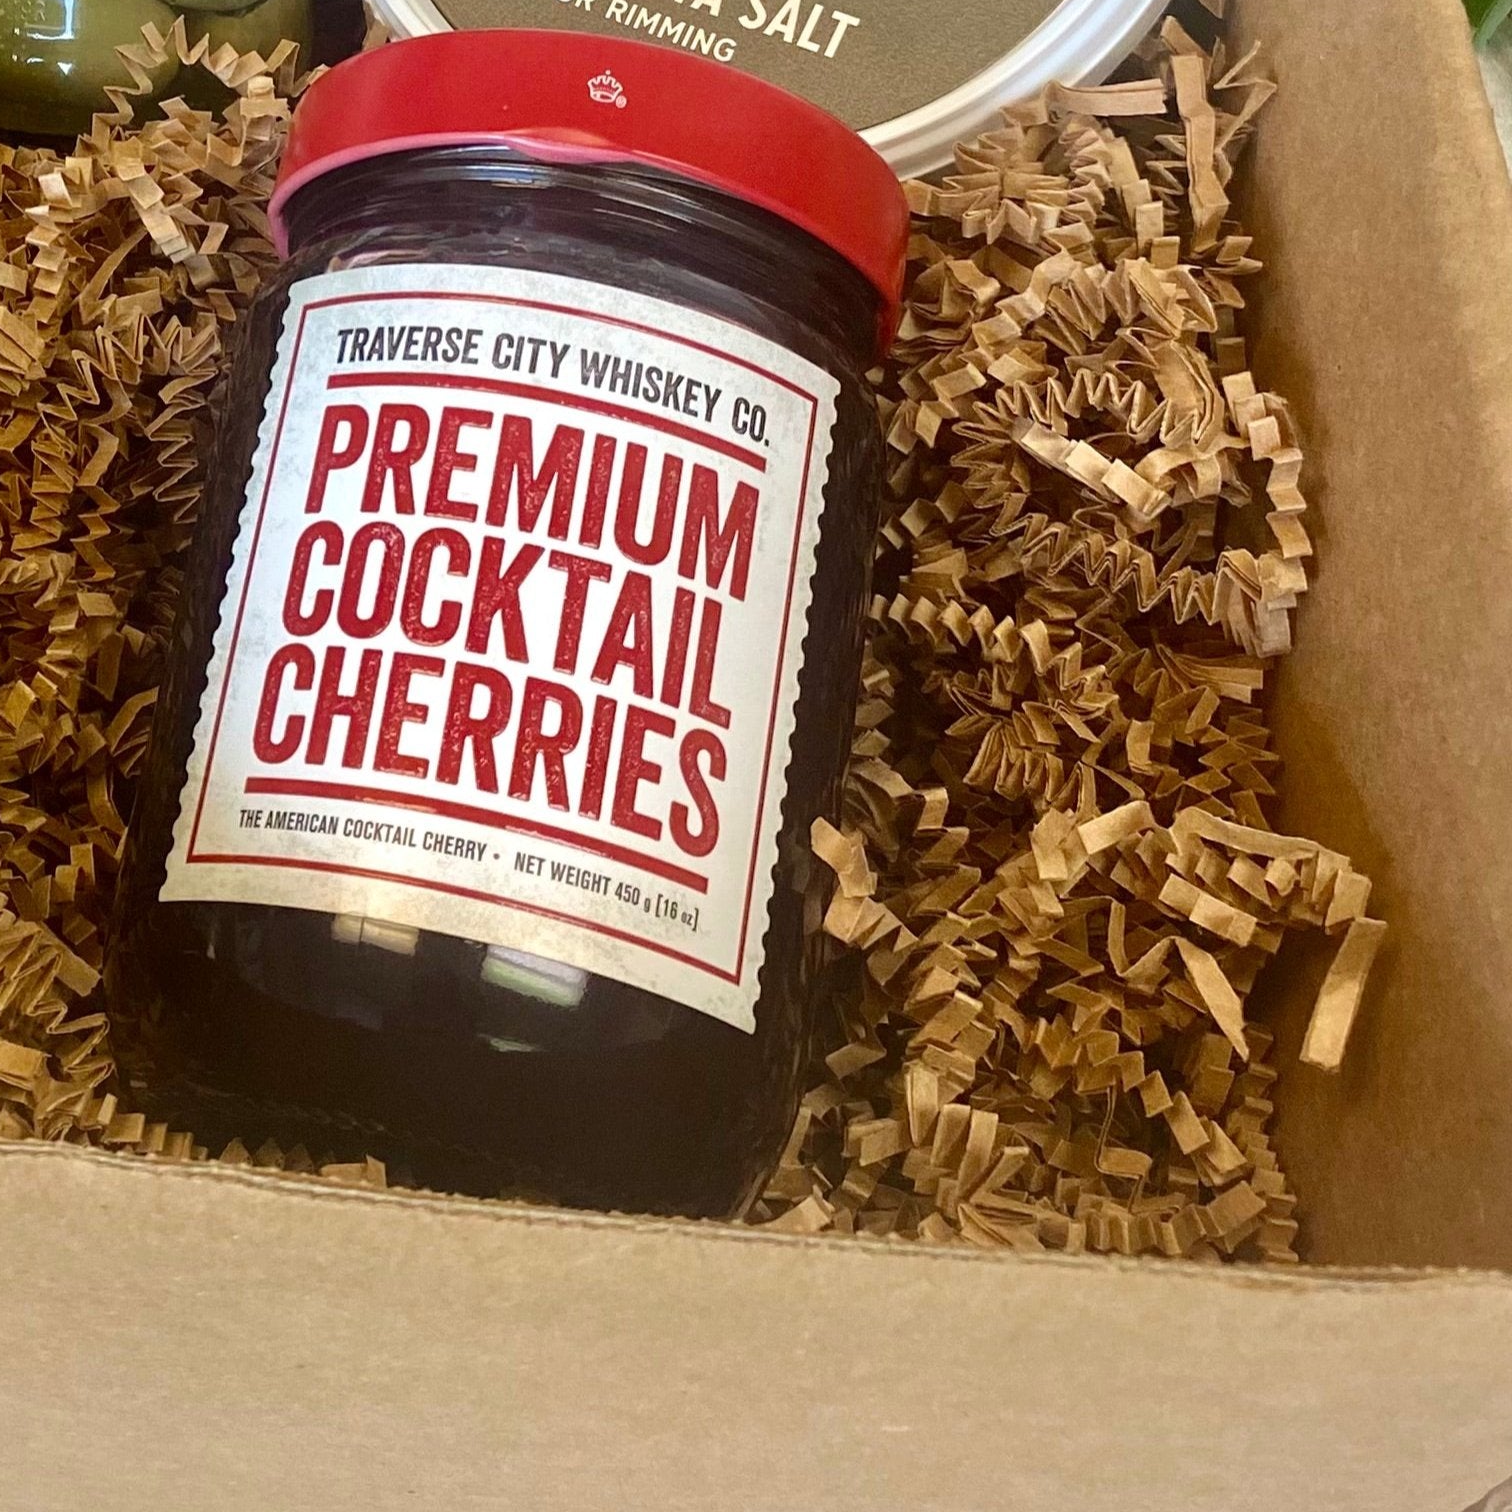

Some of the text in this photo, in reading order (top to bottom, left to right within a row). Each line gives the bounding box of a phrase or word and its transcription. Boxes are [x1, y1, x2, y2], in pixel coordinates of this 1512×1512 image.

[336, 326, 770, 447] TRAVERSE CITY WHISKEY CO.
[304, 404, 764, 603] PREMIUM
[282, 519, 733, 731] COCKTAIL
[253, 644, 730, 859] CHERRIES
[239, 809, 263, 829] THE
[264, 810, 339, 835] AMERICAN
[343, 818, 416, 848] COCKTAIL
[422, 831, 487, 862] CHERRY
[514, 851, 545, 876] NET
[550, 860, 612, 896] WEIGHT
[614, 882, 640, 906] 450
[644, 897, 651, 913] g
